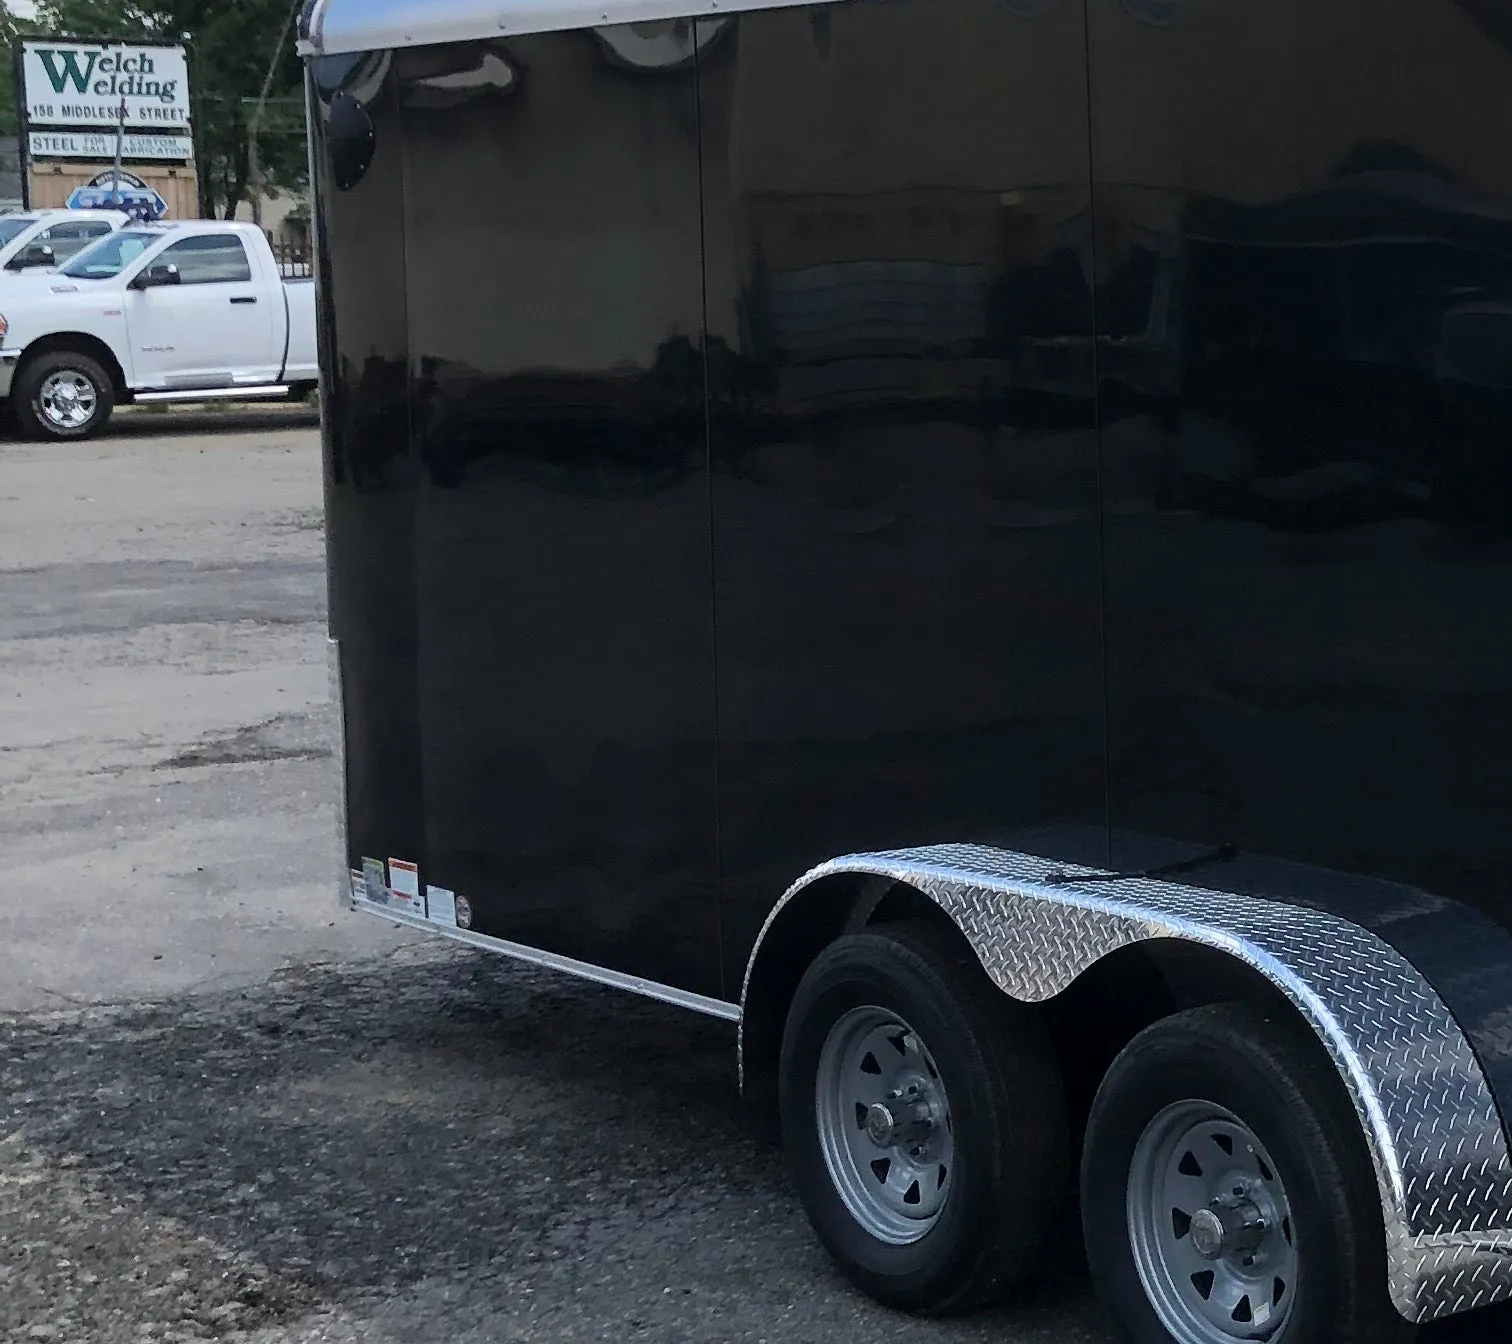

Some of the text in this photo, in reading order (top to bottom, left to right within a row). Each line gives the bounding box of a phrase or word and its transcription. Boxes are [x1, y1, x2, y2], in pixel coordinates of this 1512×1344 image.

[34, 49, 155, 93] Welch
[139, 107, 185, 121] STREET
[32, 136, 79, 152] STEEL
